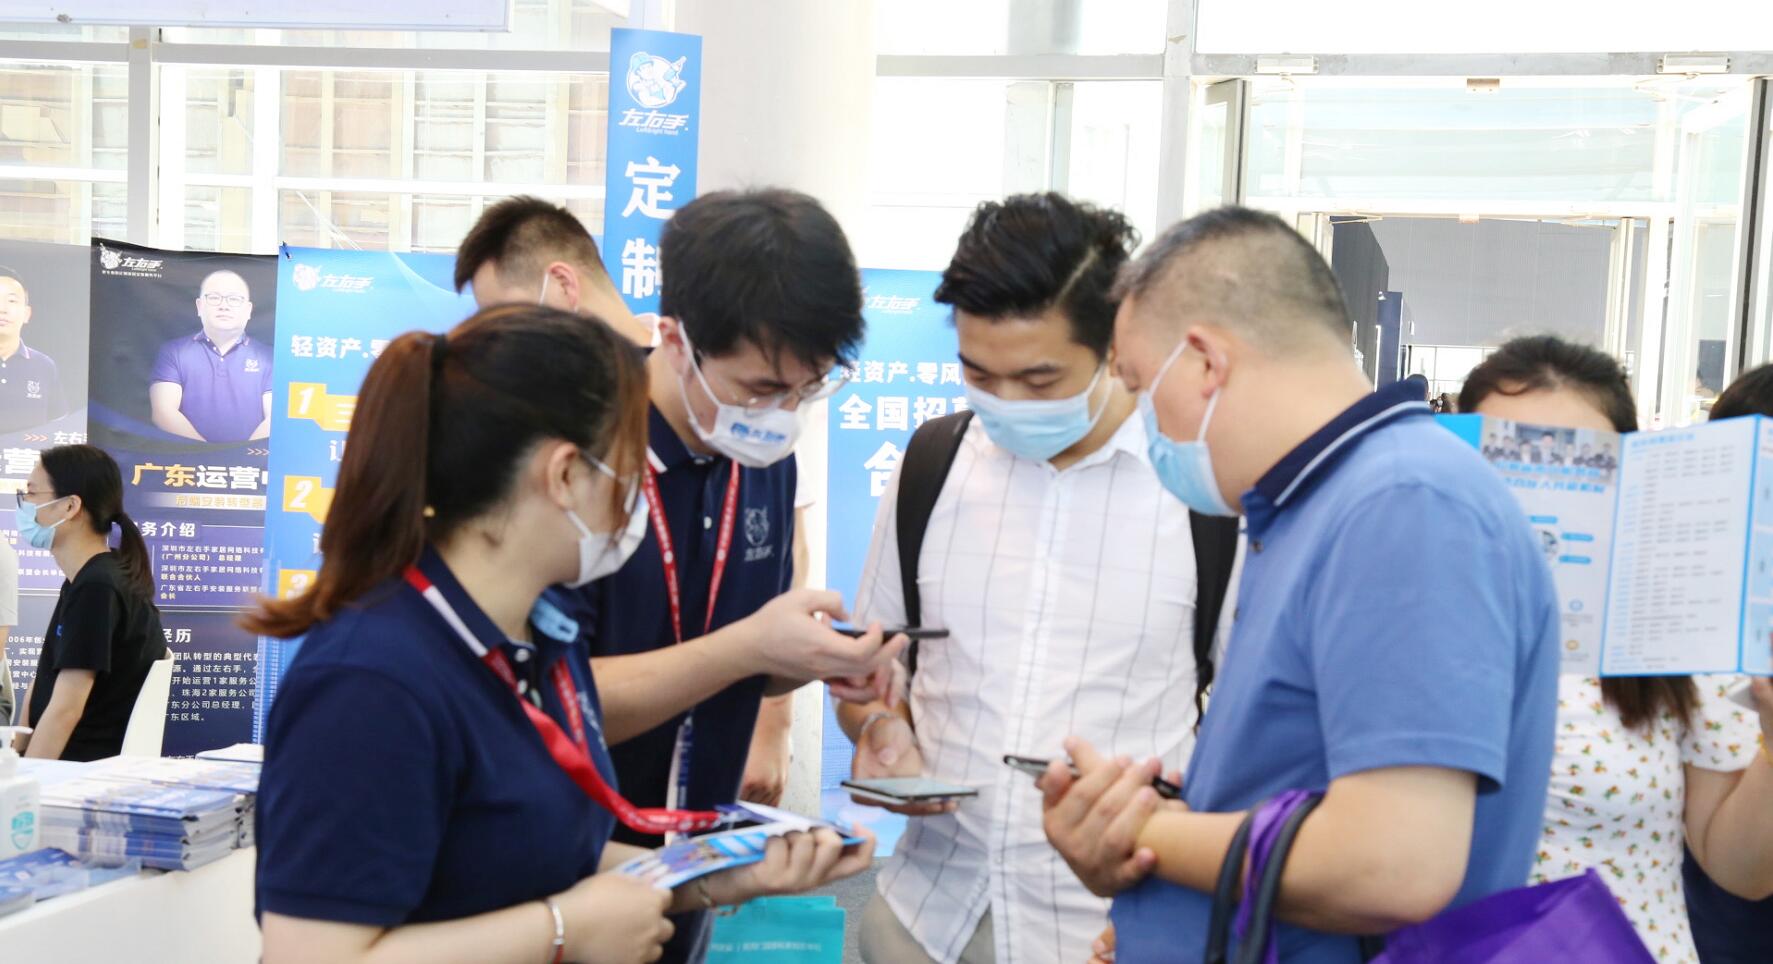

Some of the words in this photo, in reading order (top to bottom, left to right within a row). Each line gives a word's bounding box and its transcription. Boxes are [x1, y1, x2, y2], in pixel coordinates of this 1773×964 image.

[290, 480, 314, 508] 2
[134, 521, 195, 537] 务介绍
